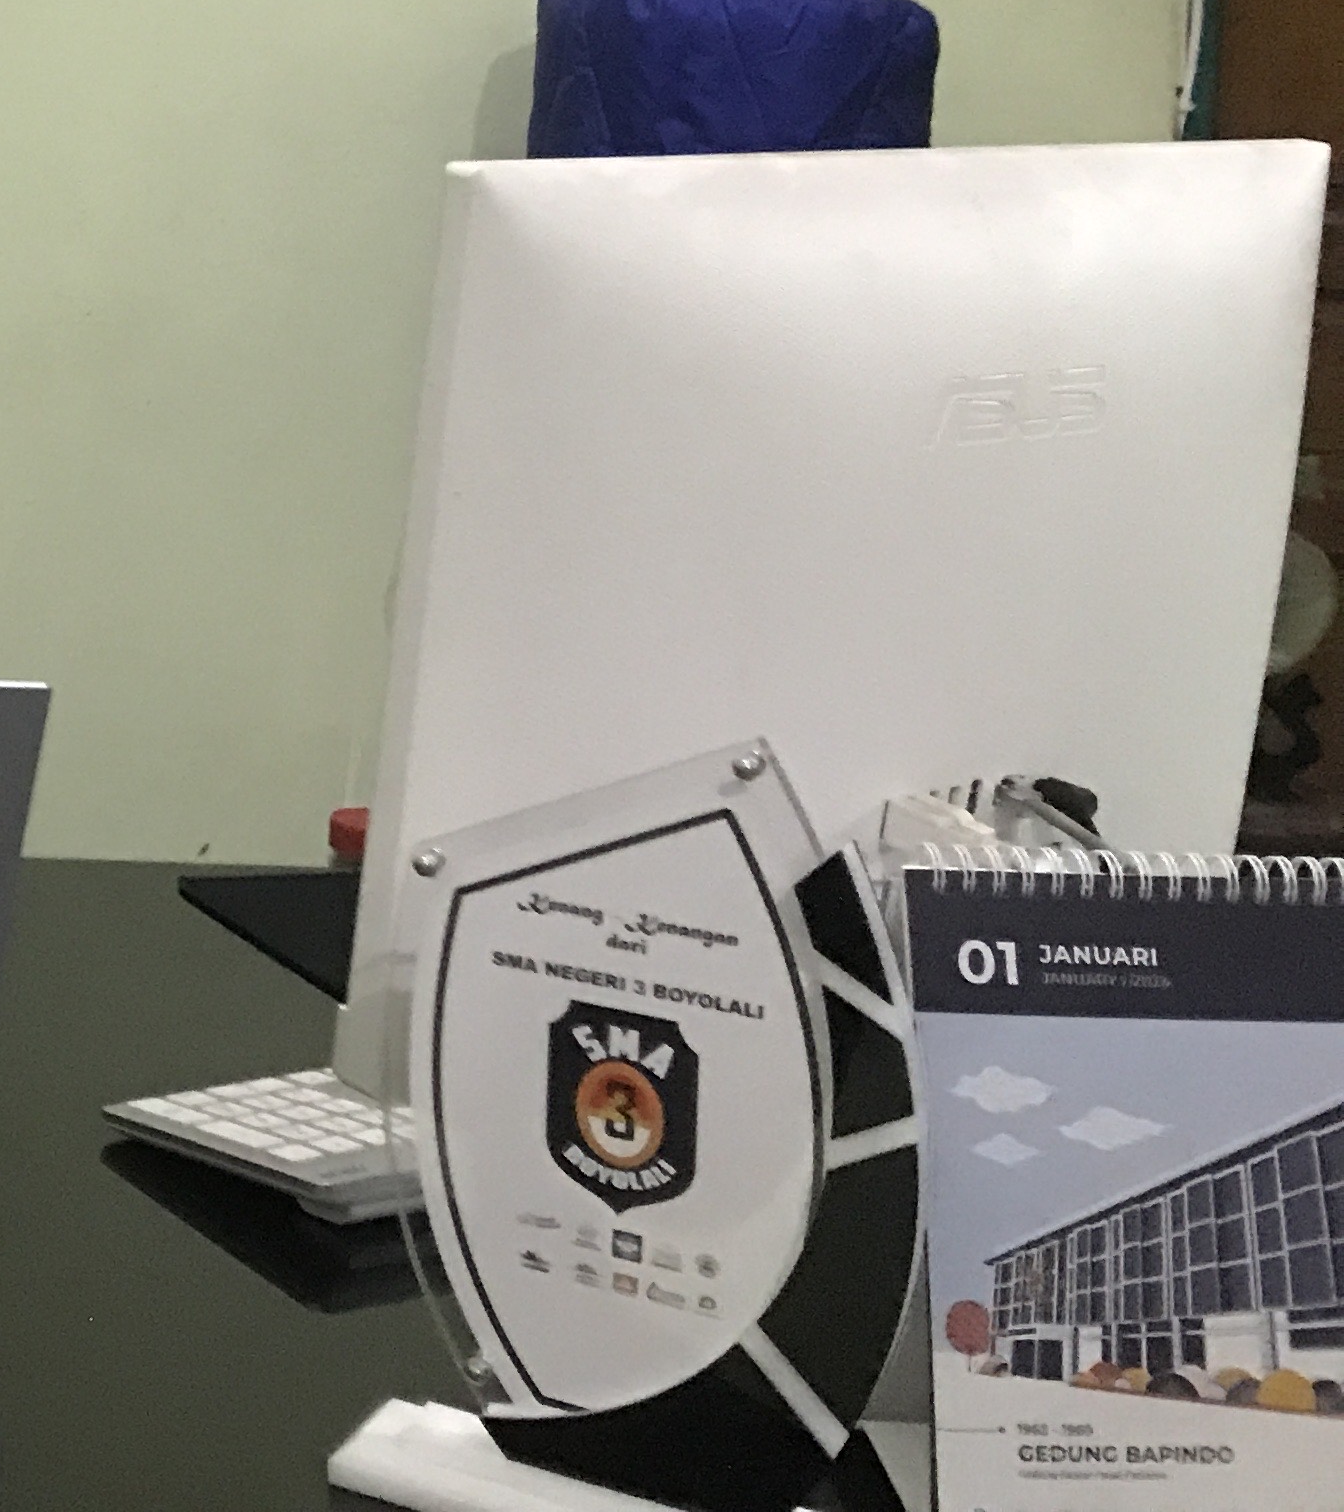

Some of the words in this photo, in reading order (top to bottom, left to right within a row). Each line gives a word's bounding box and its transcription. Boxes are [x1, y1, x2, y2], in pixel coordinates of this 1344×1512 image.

[491, 949, 539, 974] SMA
[544, 959, 627, 992] NEGERI
[652, 982, 766, 1020] BOYOLALI
[957, 938, 1020, 986] 01
[1038, 943, 1159, 967] JANUARI
[570, 1023, 675, 1081] SMA
[1018, 1443, 1118, 1464] GEDUNG
[1124, 1444, 1236, 1465] BAPINDO
